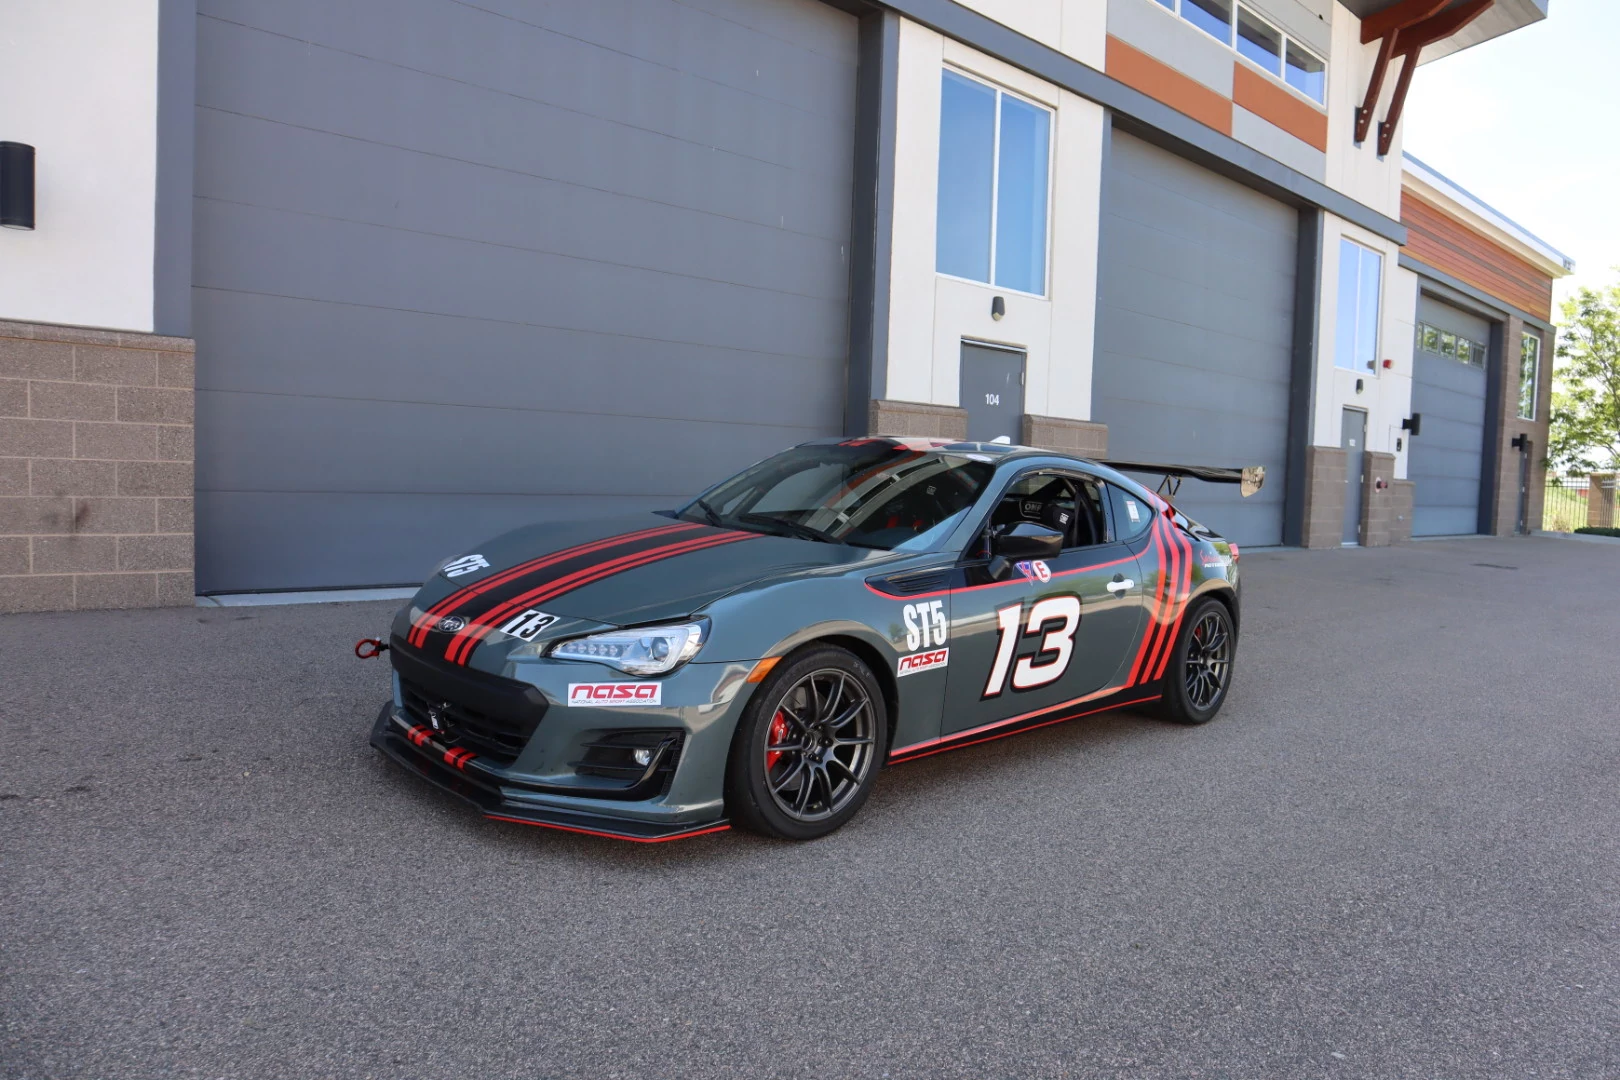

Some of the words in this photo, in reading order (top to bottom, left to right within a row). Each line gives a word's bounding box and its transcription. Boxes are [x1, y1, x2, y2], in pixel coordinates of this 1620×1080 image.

[985, 393, 1000, 406] 104
[1034, 562, 1048, 578] E
[507, 613, 555, 638] 13
[903, 600, 947, 651] ST5
[981, 593, 1083, 700] 13
